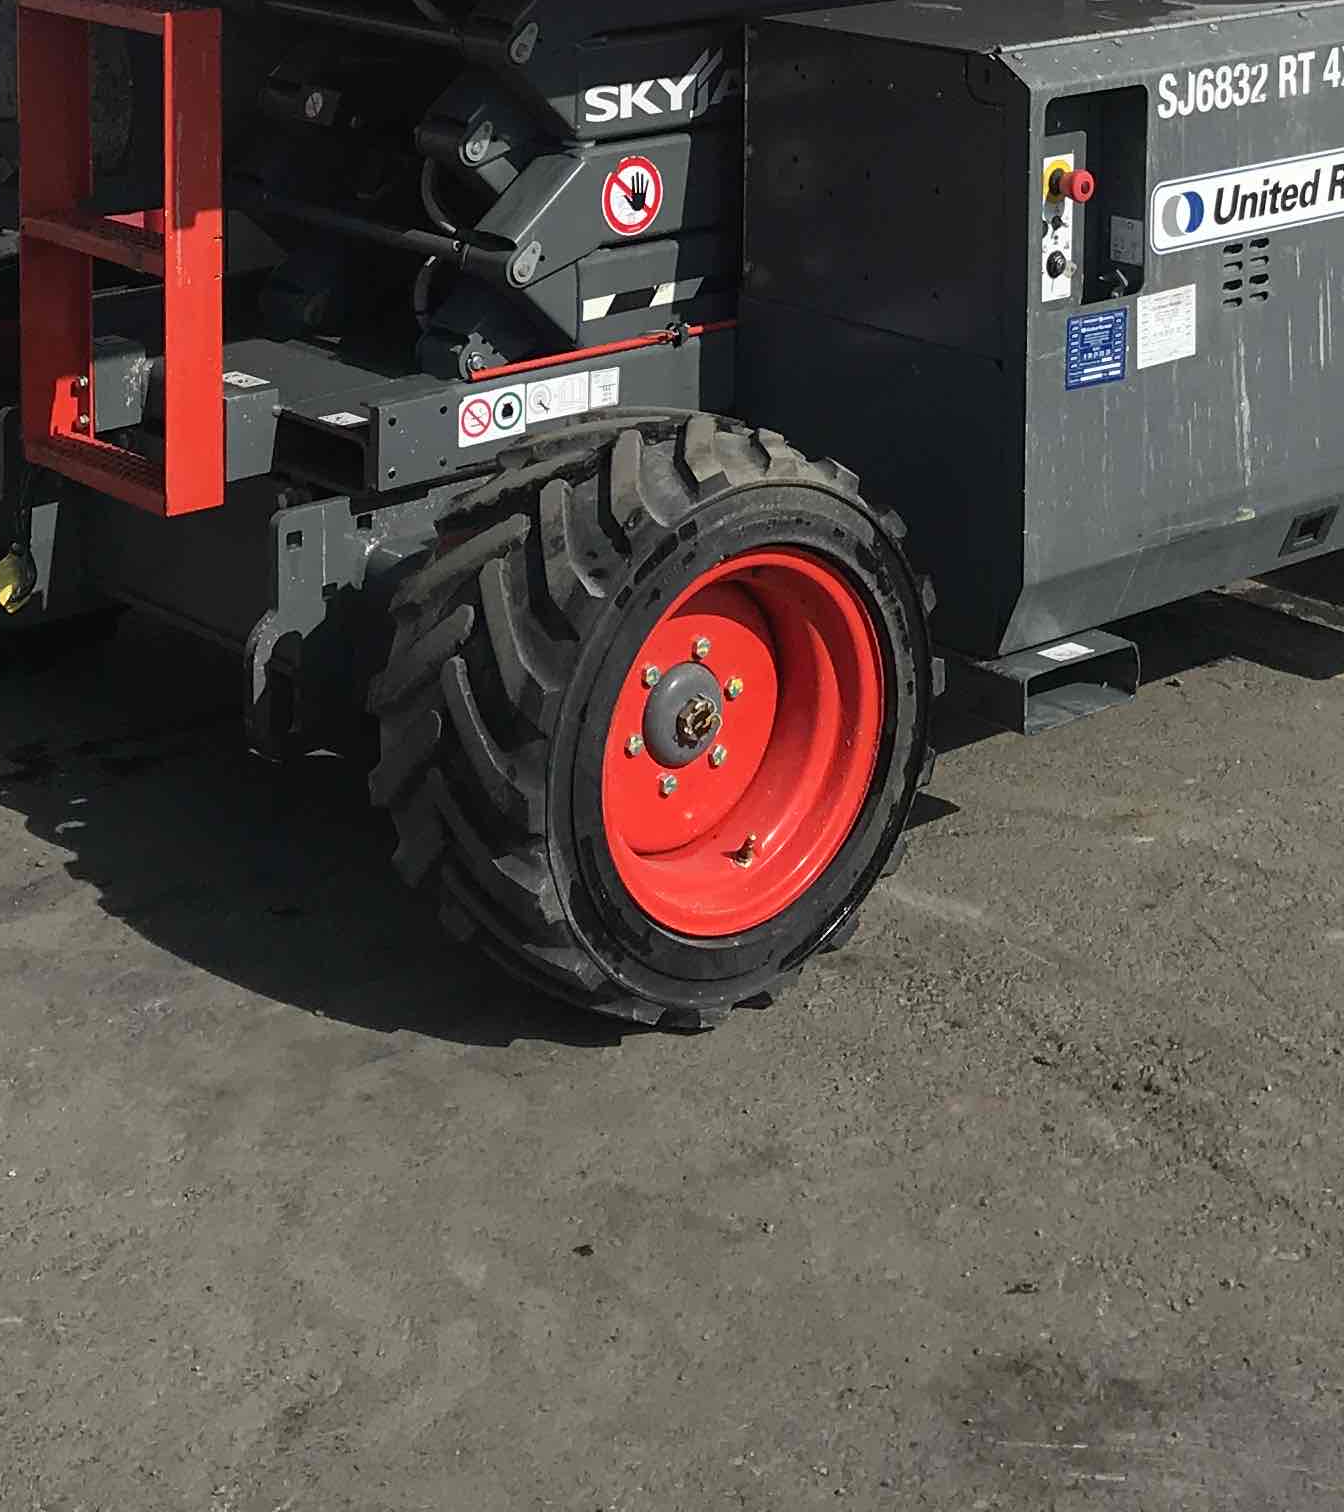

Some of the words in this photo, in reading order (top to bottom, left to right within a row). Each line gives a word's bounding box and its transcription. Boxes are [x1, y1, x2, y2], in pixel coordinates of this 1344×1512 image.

[1157, 62, 1269, 121] SJ6832
[1278, 50, 1316, 99] RT
[1212, 168, 1321, 226] United
